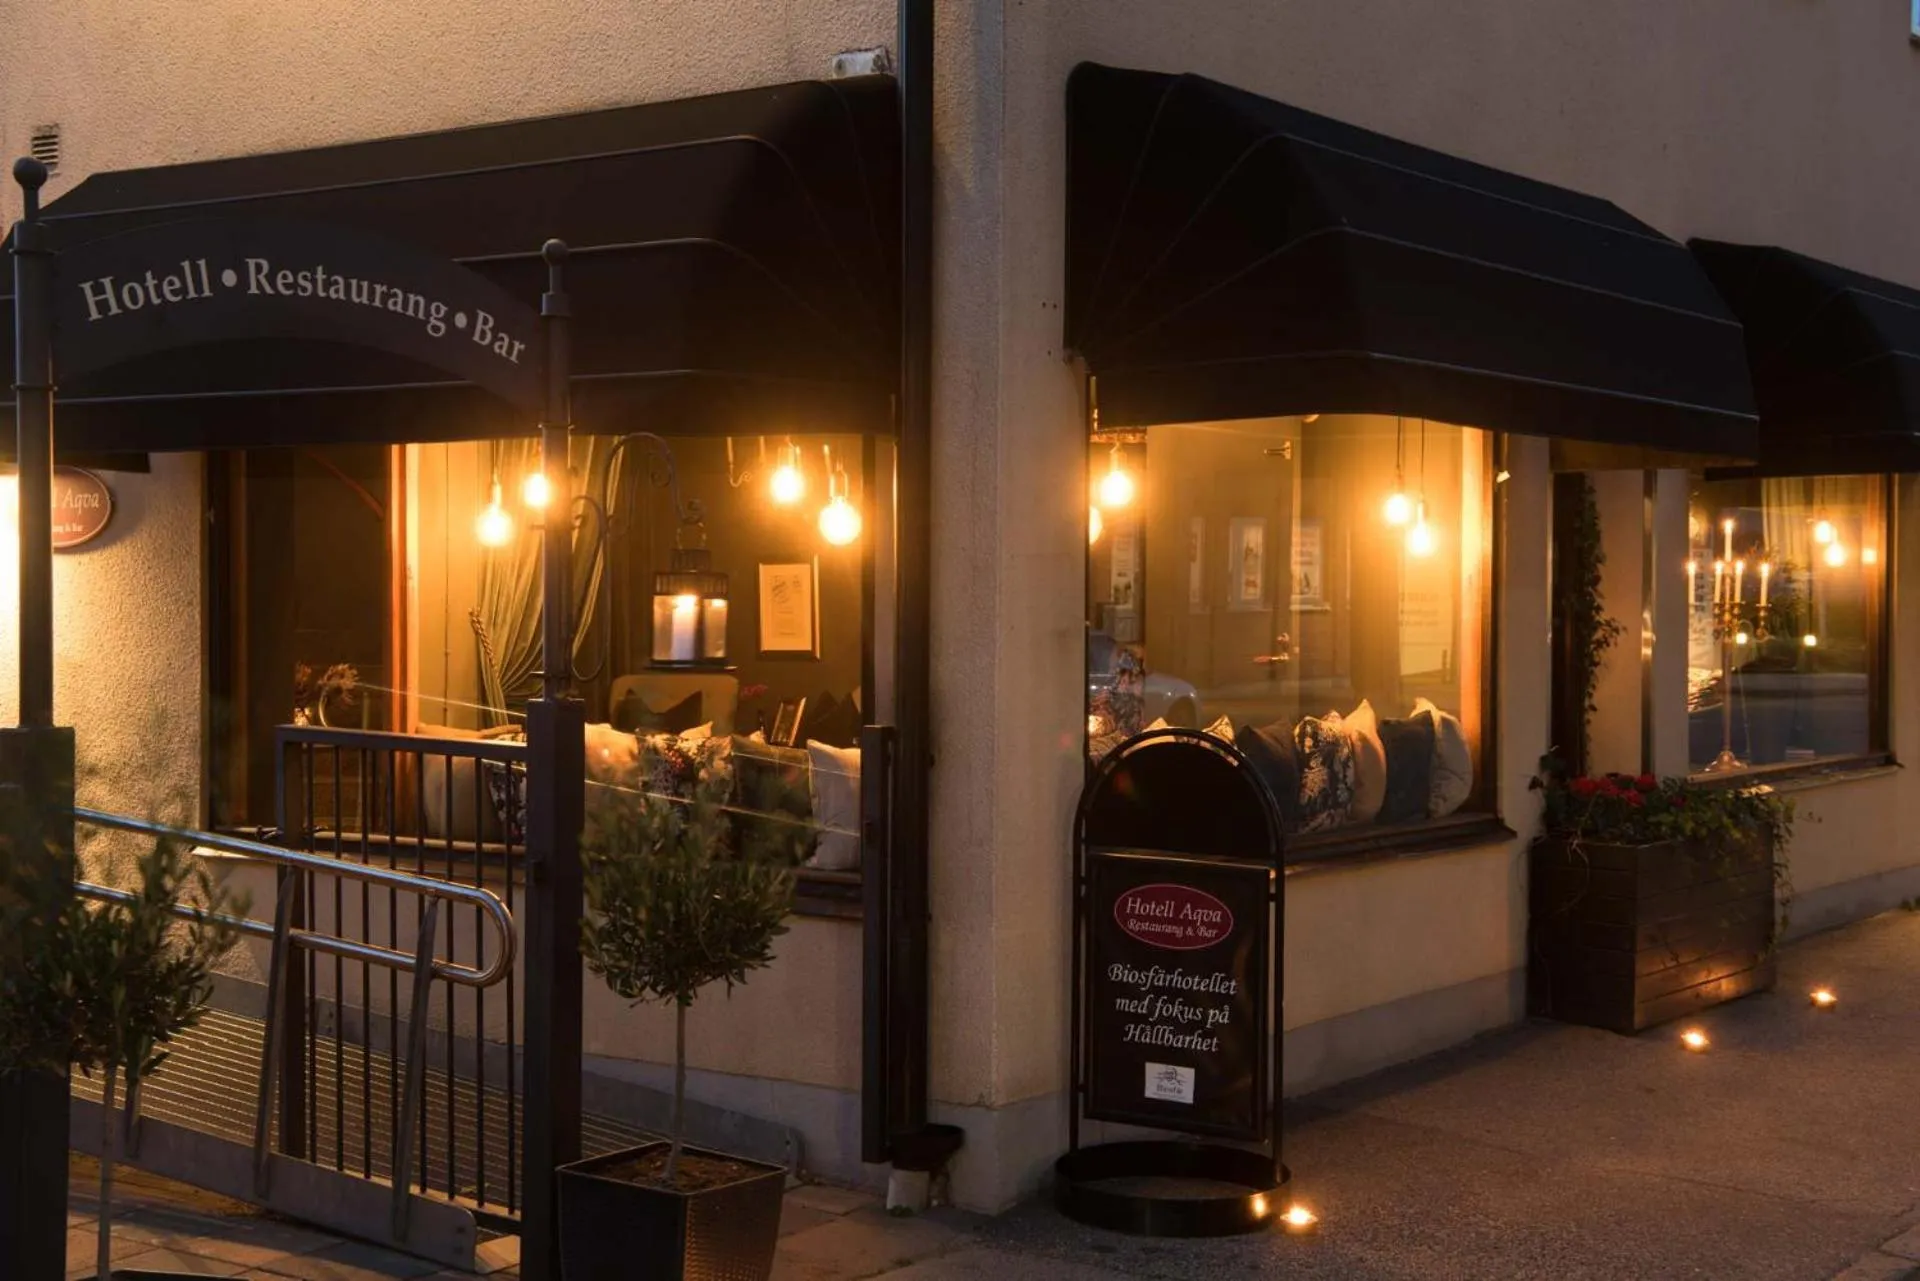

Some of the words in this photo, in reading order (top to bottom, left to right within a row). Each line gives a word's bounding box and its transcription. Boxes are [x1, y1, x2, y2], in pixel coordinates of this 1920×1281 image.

[78, 258, 213, 321] Hotell
[245, 257, 448, 337] Restaurang
[472, 309, 526, 364] Bar
[61, 487, 99, 515] Aqva
[1126, 897, 1175, 918] Hotell
[1179, 903, 1222, 926] Aqva
[1127, 918, 1184, 938] Restaurang
[1196, 926, 1218, 938] Bar
[1108, 963, 1238, 995] Biosfärhotellet
[1115, 994, 1154, 1014] med
[1148, 996, 1203, 1023] fokus
[1206, 1005, 1230, 1028] på
[1123, 1023, 1219, 1052] Hållbarhet
